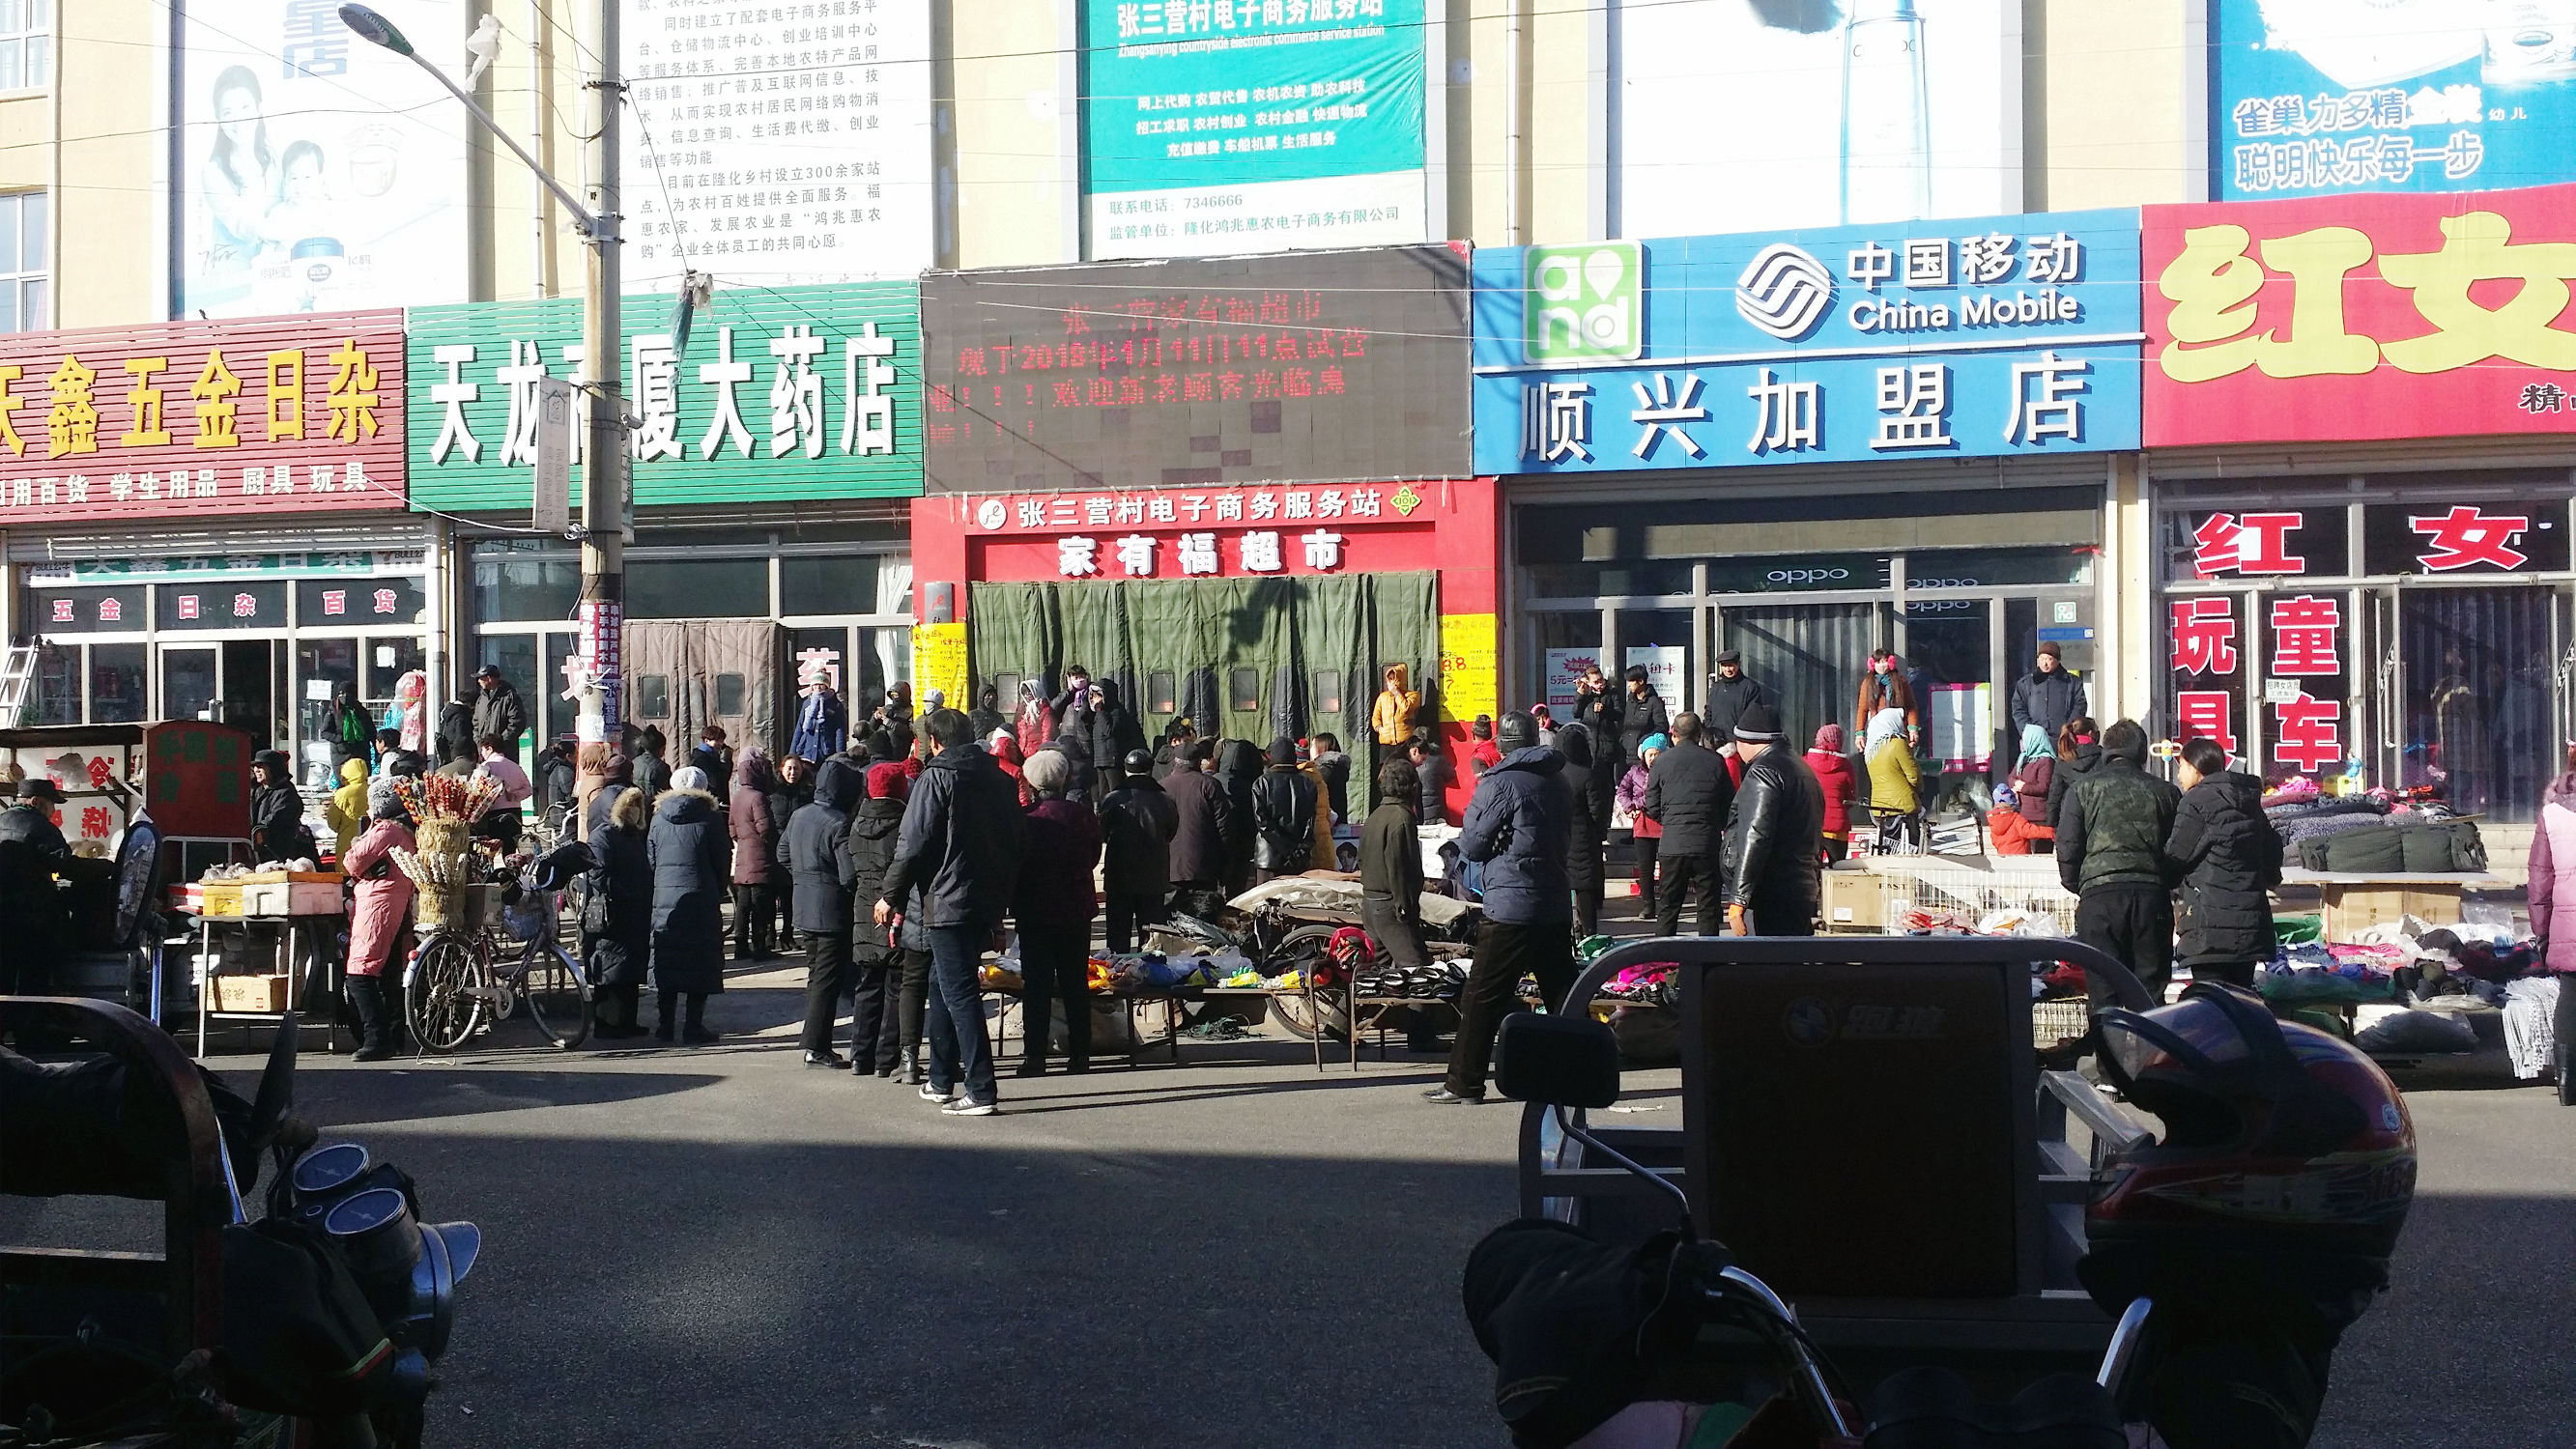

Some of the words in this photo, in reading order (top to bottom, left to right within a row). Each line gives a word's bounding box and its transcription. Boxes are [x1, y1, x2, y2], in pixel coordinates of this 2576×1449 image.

[664, 1, 877, 31] 同时建立了配套电子商务服务平
[1117, 0, 1384, 38] 张三营村电子商务服务站
[639, 23, 877, 56] 台、仓储物流中心、创业培训中心
[1118, 41, 1178, 58] Zhangsanying
[1179, 35, 1229, 53] countryside
[1230, 33, 1272, 48] electronic
[1274, 29, 1320, 44] commerce
[1321, 25, 1352, 41] service
[1354, 22, 1385, 38] station
[638, 44, 878, 78] 等服务体系、完善本地农特产品网
[1138, 94, 1190, 110] 网上代购
[1311, 79, 1365, 96] 助农科技
[1136, 118, 1189, 134] 招工求职
[1194, 114, 1246, 131] 农村创业
[1255, 108, 1308, 126] 农村金融
[1313, 103, 1367, 122] 快递物流
[1224, 136, 1278, 153] 车船机票
[1283, 131, 1336, 149] 生活服务
[2235, 130, 2484, 191] 聪明快乐每一步
[668, 161, 880, 190] 目前在隆化乡村设立300余家站
[1185, 194, 1244, 210] 7346666
[1185, 206, 1400, 236] 隆化鸿兆惠农电子商务有限公司
[1847, 231, 2079, 291] 中国移动
[1848, 298, 1950, 331] China
[1961, 288, 2078, 326] Mobile
[2159, 211, 2576, 384] 红女
[430, 322, 898, 468] 天龙厦大药店
[1519, 352, 2087, 463] 顺兴加盟店
[2518, 383, 2576, 413] 精
[109, 469, 218, 501] 学生用品
[242, 465, 294, 496] 厨具
[309, 461, 368, 493] 玩具
[1017, 488, 1382, 527] 张三营村电子商务服务站
[1057, 526, 1344, 578] 家有福超市
[52, 596, 122, 623] 五金
[177, 592, 257, 620] 日杂
[322, 587, 399, 615] 百货
[795, 646, 840, 699] 药
[2271, 594, 2342, 774] 童车
